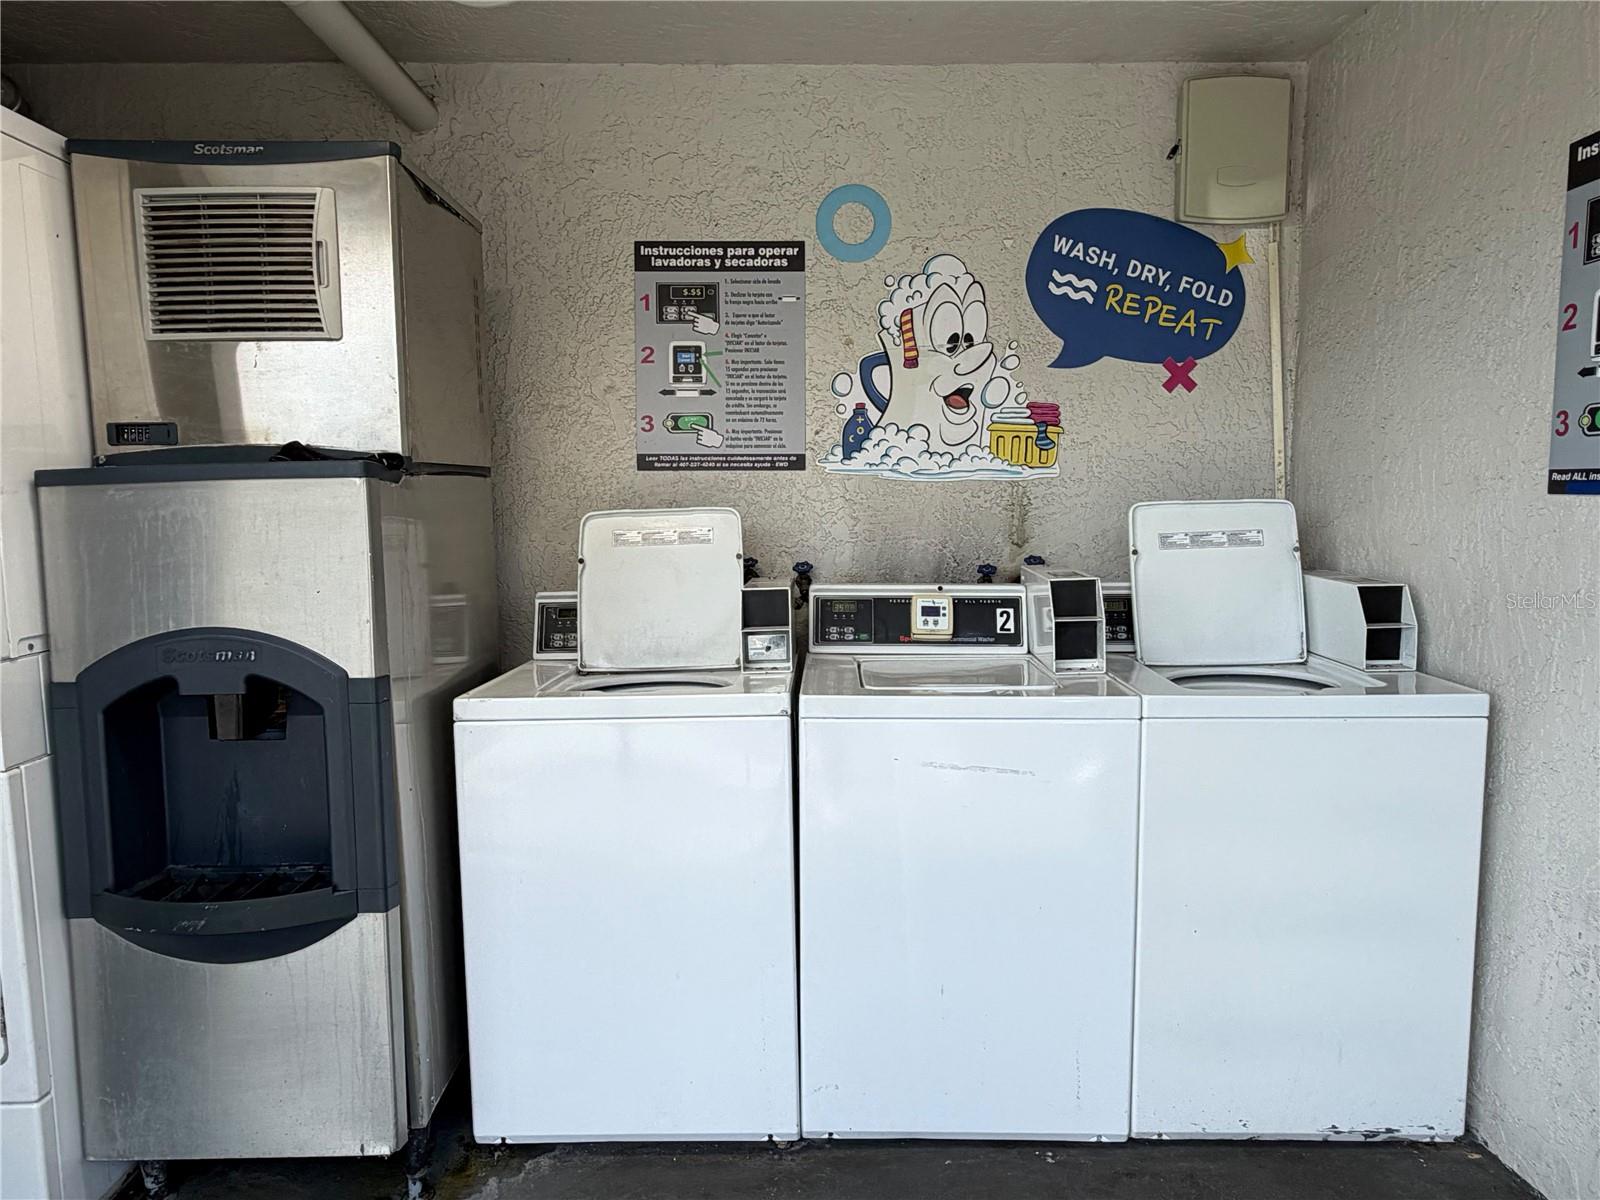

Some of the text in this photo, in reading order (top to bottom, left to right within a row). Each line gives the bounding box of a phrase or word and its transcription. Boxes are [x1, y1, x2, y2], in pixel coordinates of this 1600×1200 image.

[193, 143, 264, 155] Scotsman
[1577, 141, 1600, 162] Ins
[1568, 221, 1579, 249] 1
[640, 246, 799, 257] Instrucciones para operar
[651, 256, 788, 269] lavadoras y secadoras
[1053, 234, 1234, 308] WASH, DRY, FOLD
[640, 294, 650, 312] 1
[1105, 283, 1223, 341] REPEAT
[1562, 302, 1578, 332] 2
[640, 346, 655, 364] 2
[640, 415, 655, 432] 3
[1555, 410, 1569, 437] 3
[1551, 472, 1571, 481] Read
[1572, 472, 1587, 481] ALL
[999, 610, 1011, 632] 2
